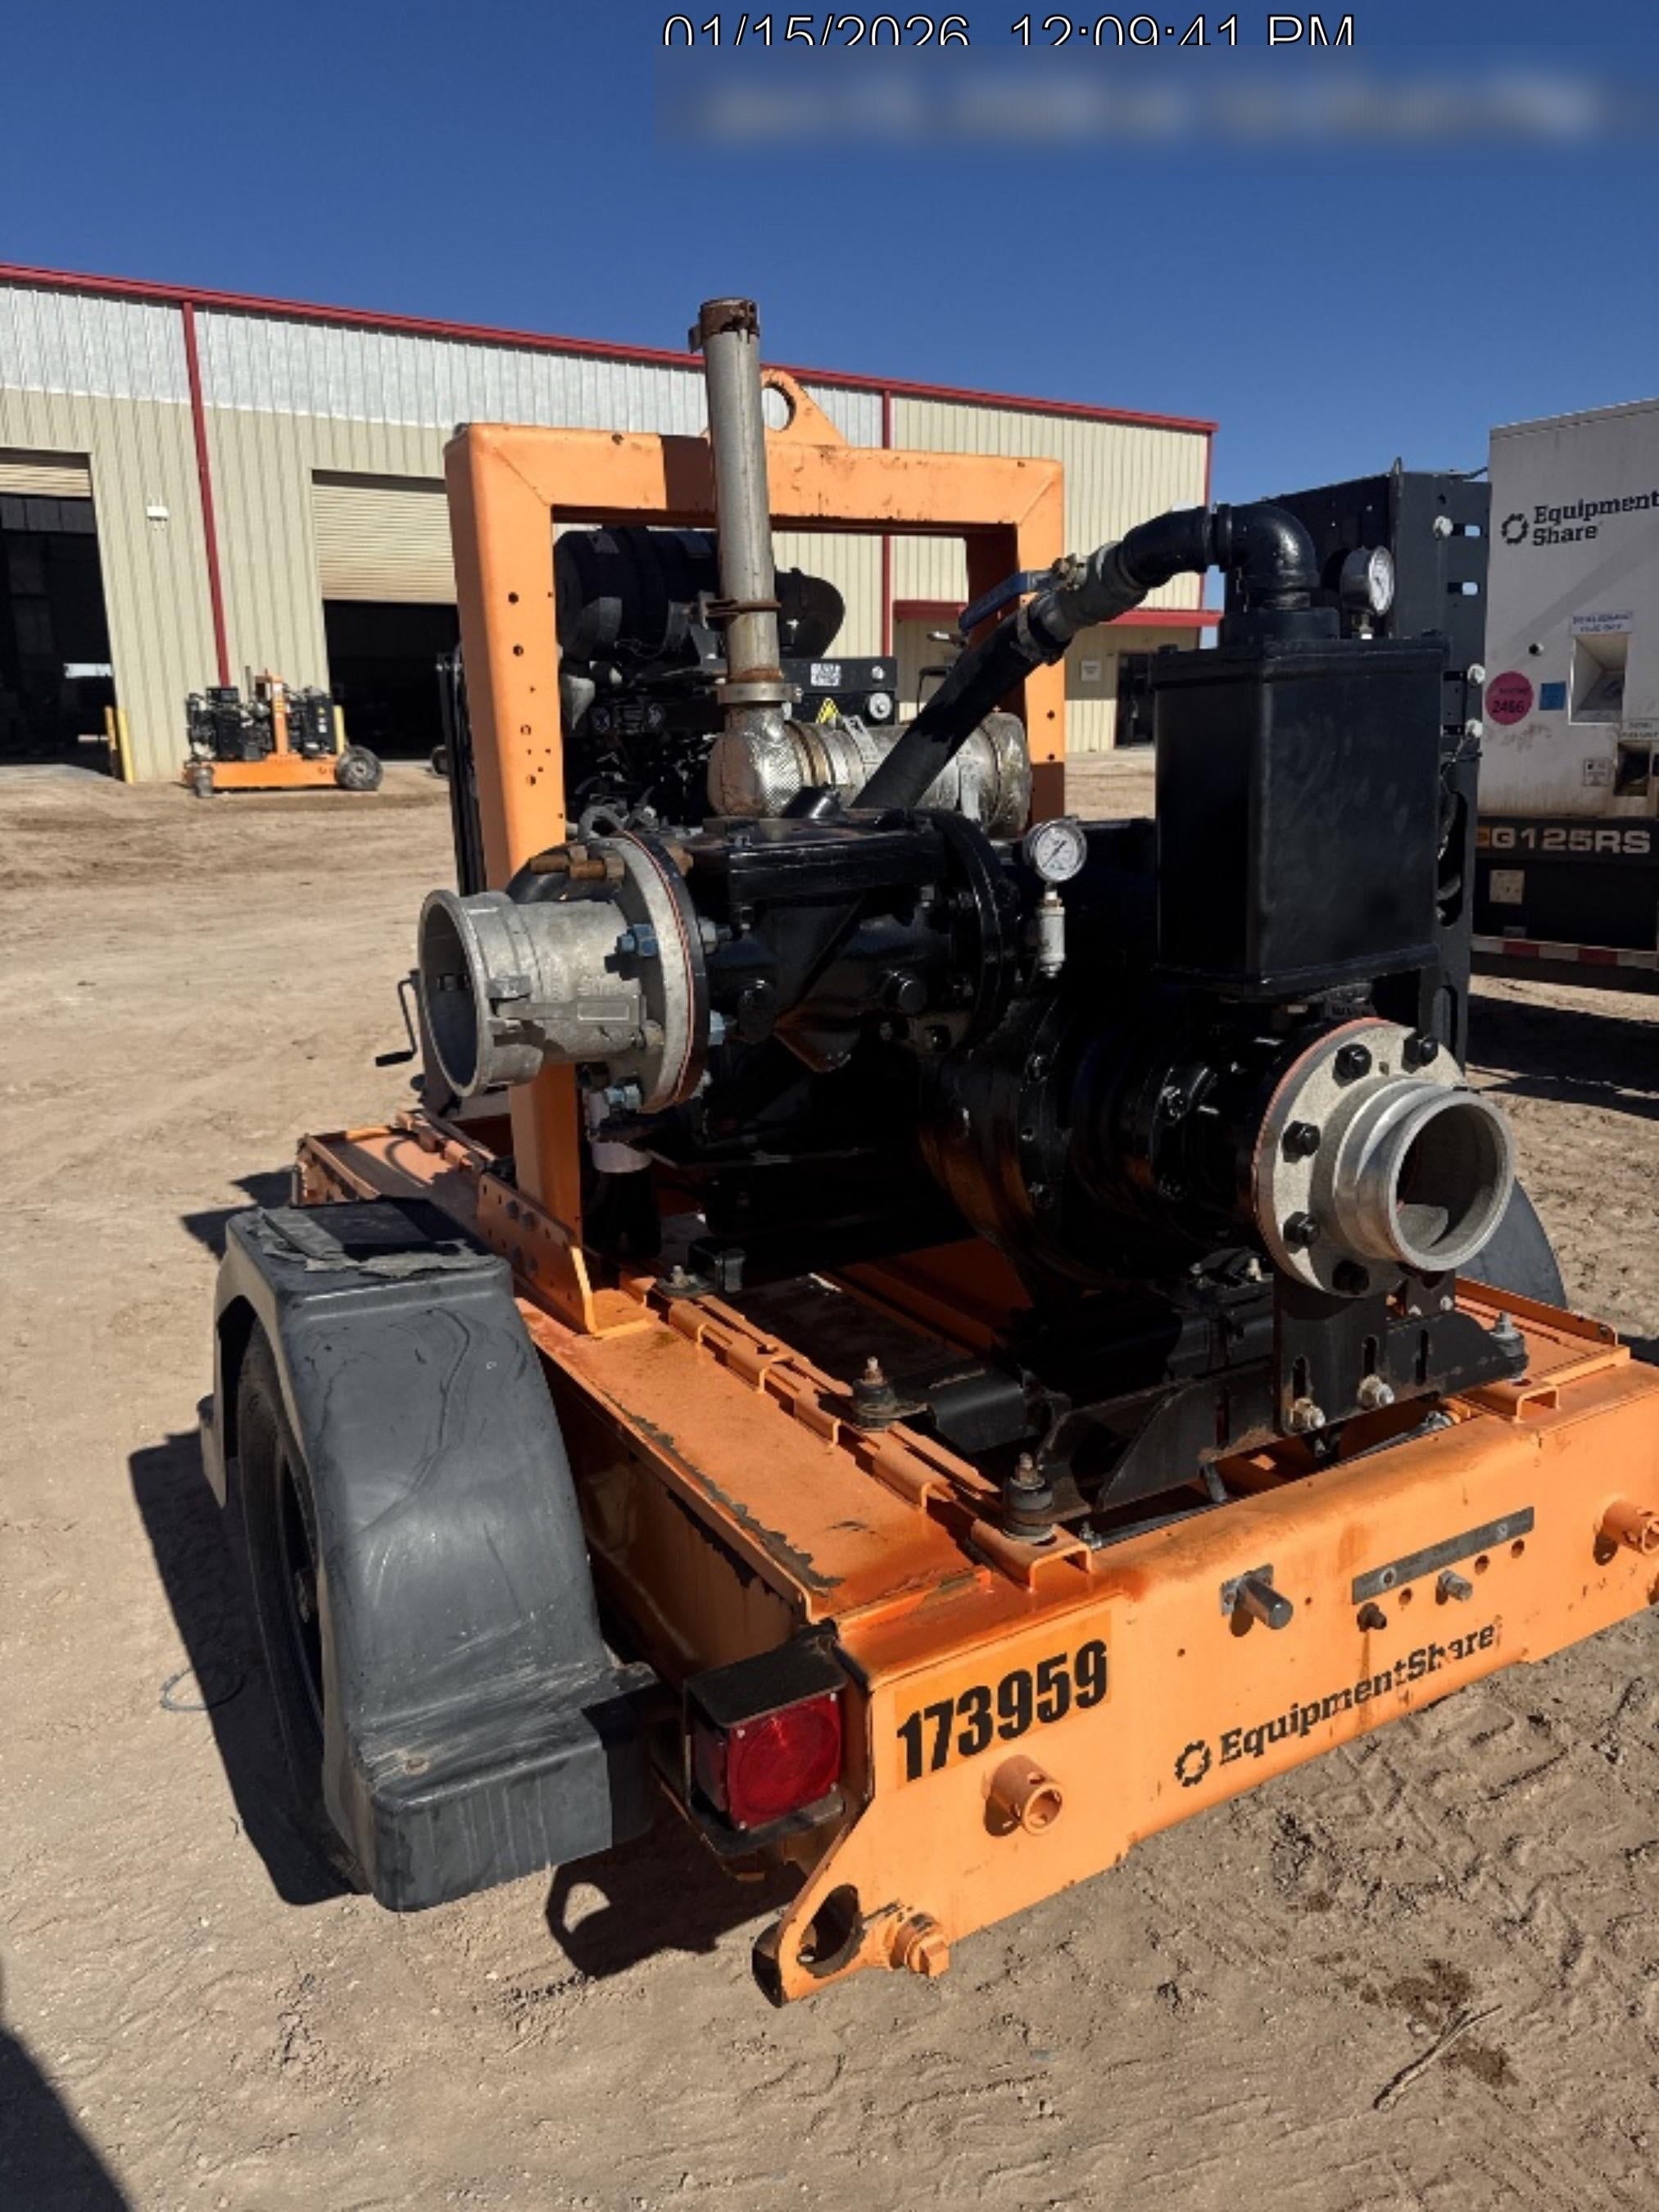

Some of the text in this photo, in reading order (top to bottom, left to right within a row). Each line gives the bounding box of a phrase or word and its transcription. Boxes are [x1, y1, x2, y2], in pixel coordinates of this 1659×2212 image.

[1533, 525, 1598, 546] Share
[1534, 490, 1659, 526] Equipment
[896, 1639, 1108, 1783] 173959
[1219, 1622, 1494, 1766] EquipmentShare
